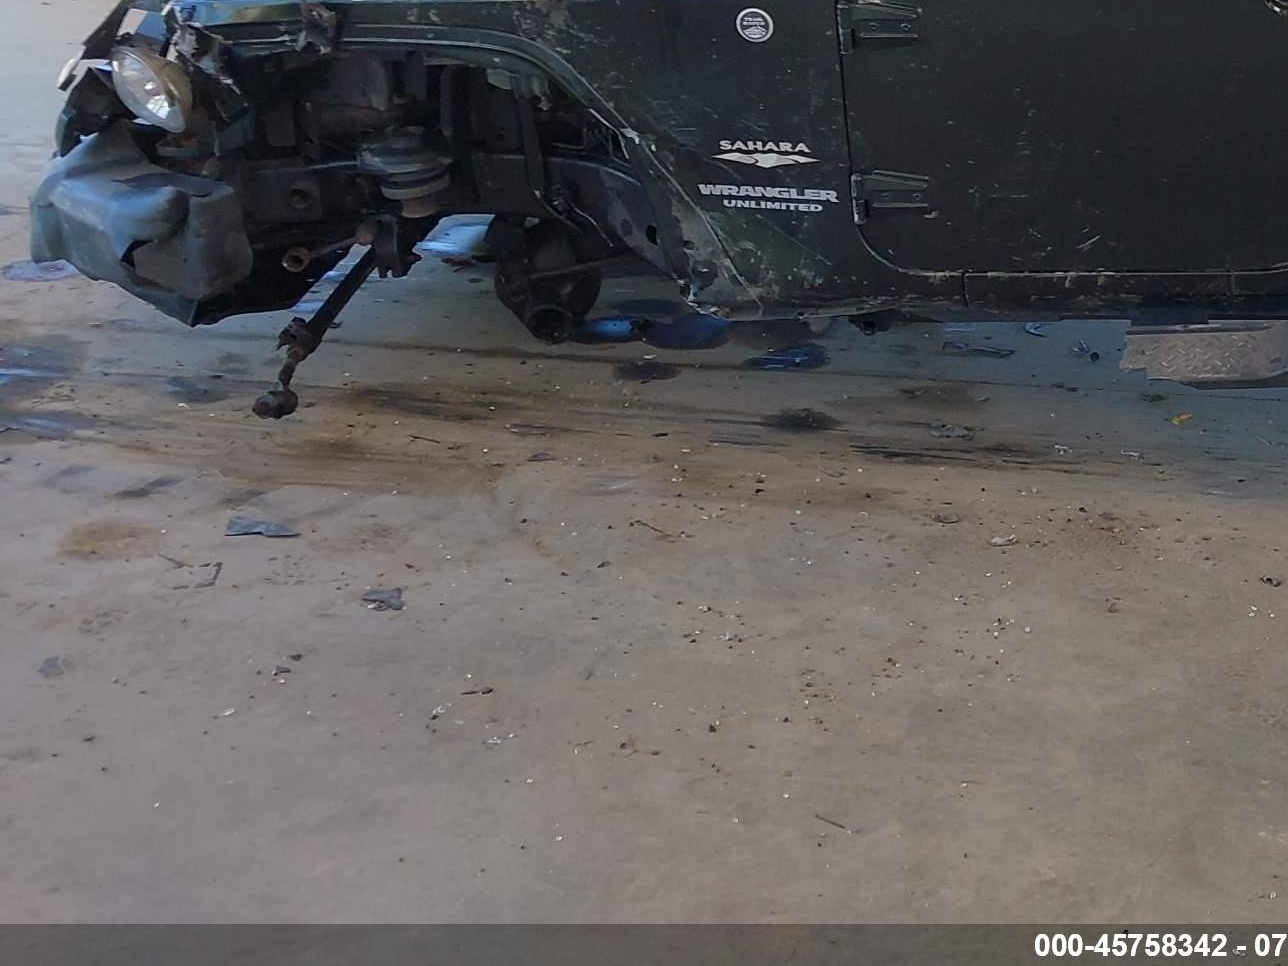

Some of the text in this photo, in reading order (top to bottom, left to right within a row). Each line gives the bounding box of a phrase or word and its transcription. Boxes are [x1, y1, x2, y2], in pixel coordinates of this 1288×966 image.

[719, 140, 811, 153] SAHARA
[698, 184, 840, 203] WRANGLER
[723, 198, 824, 212] UNLIMITED
